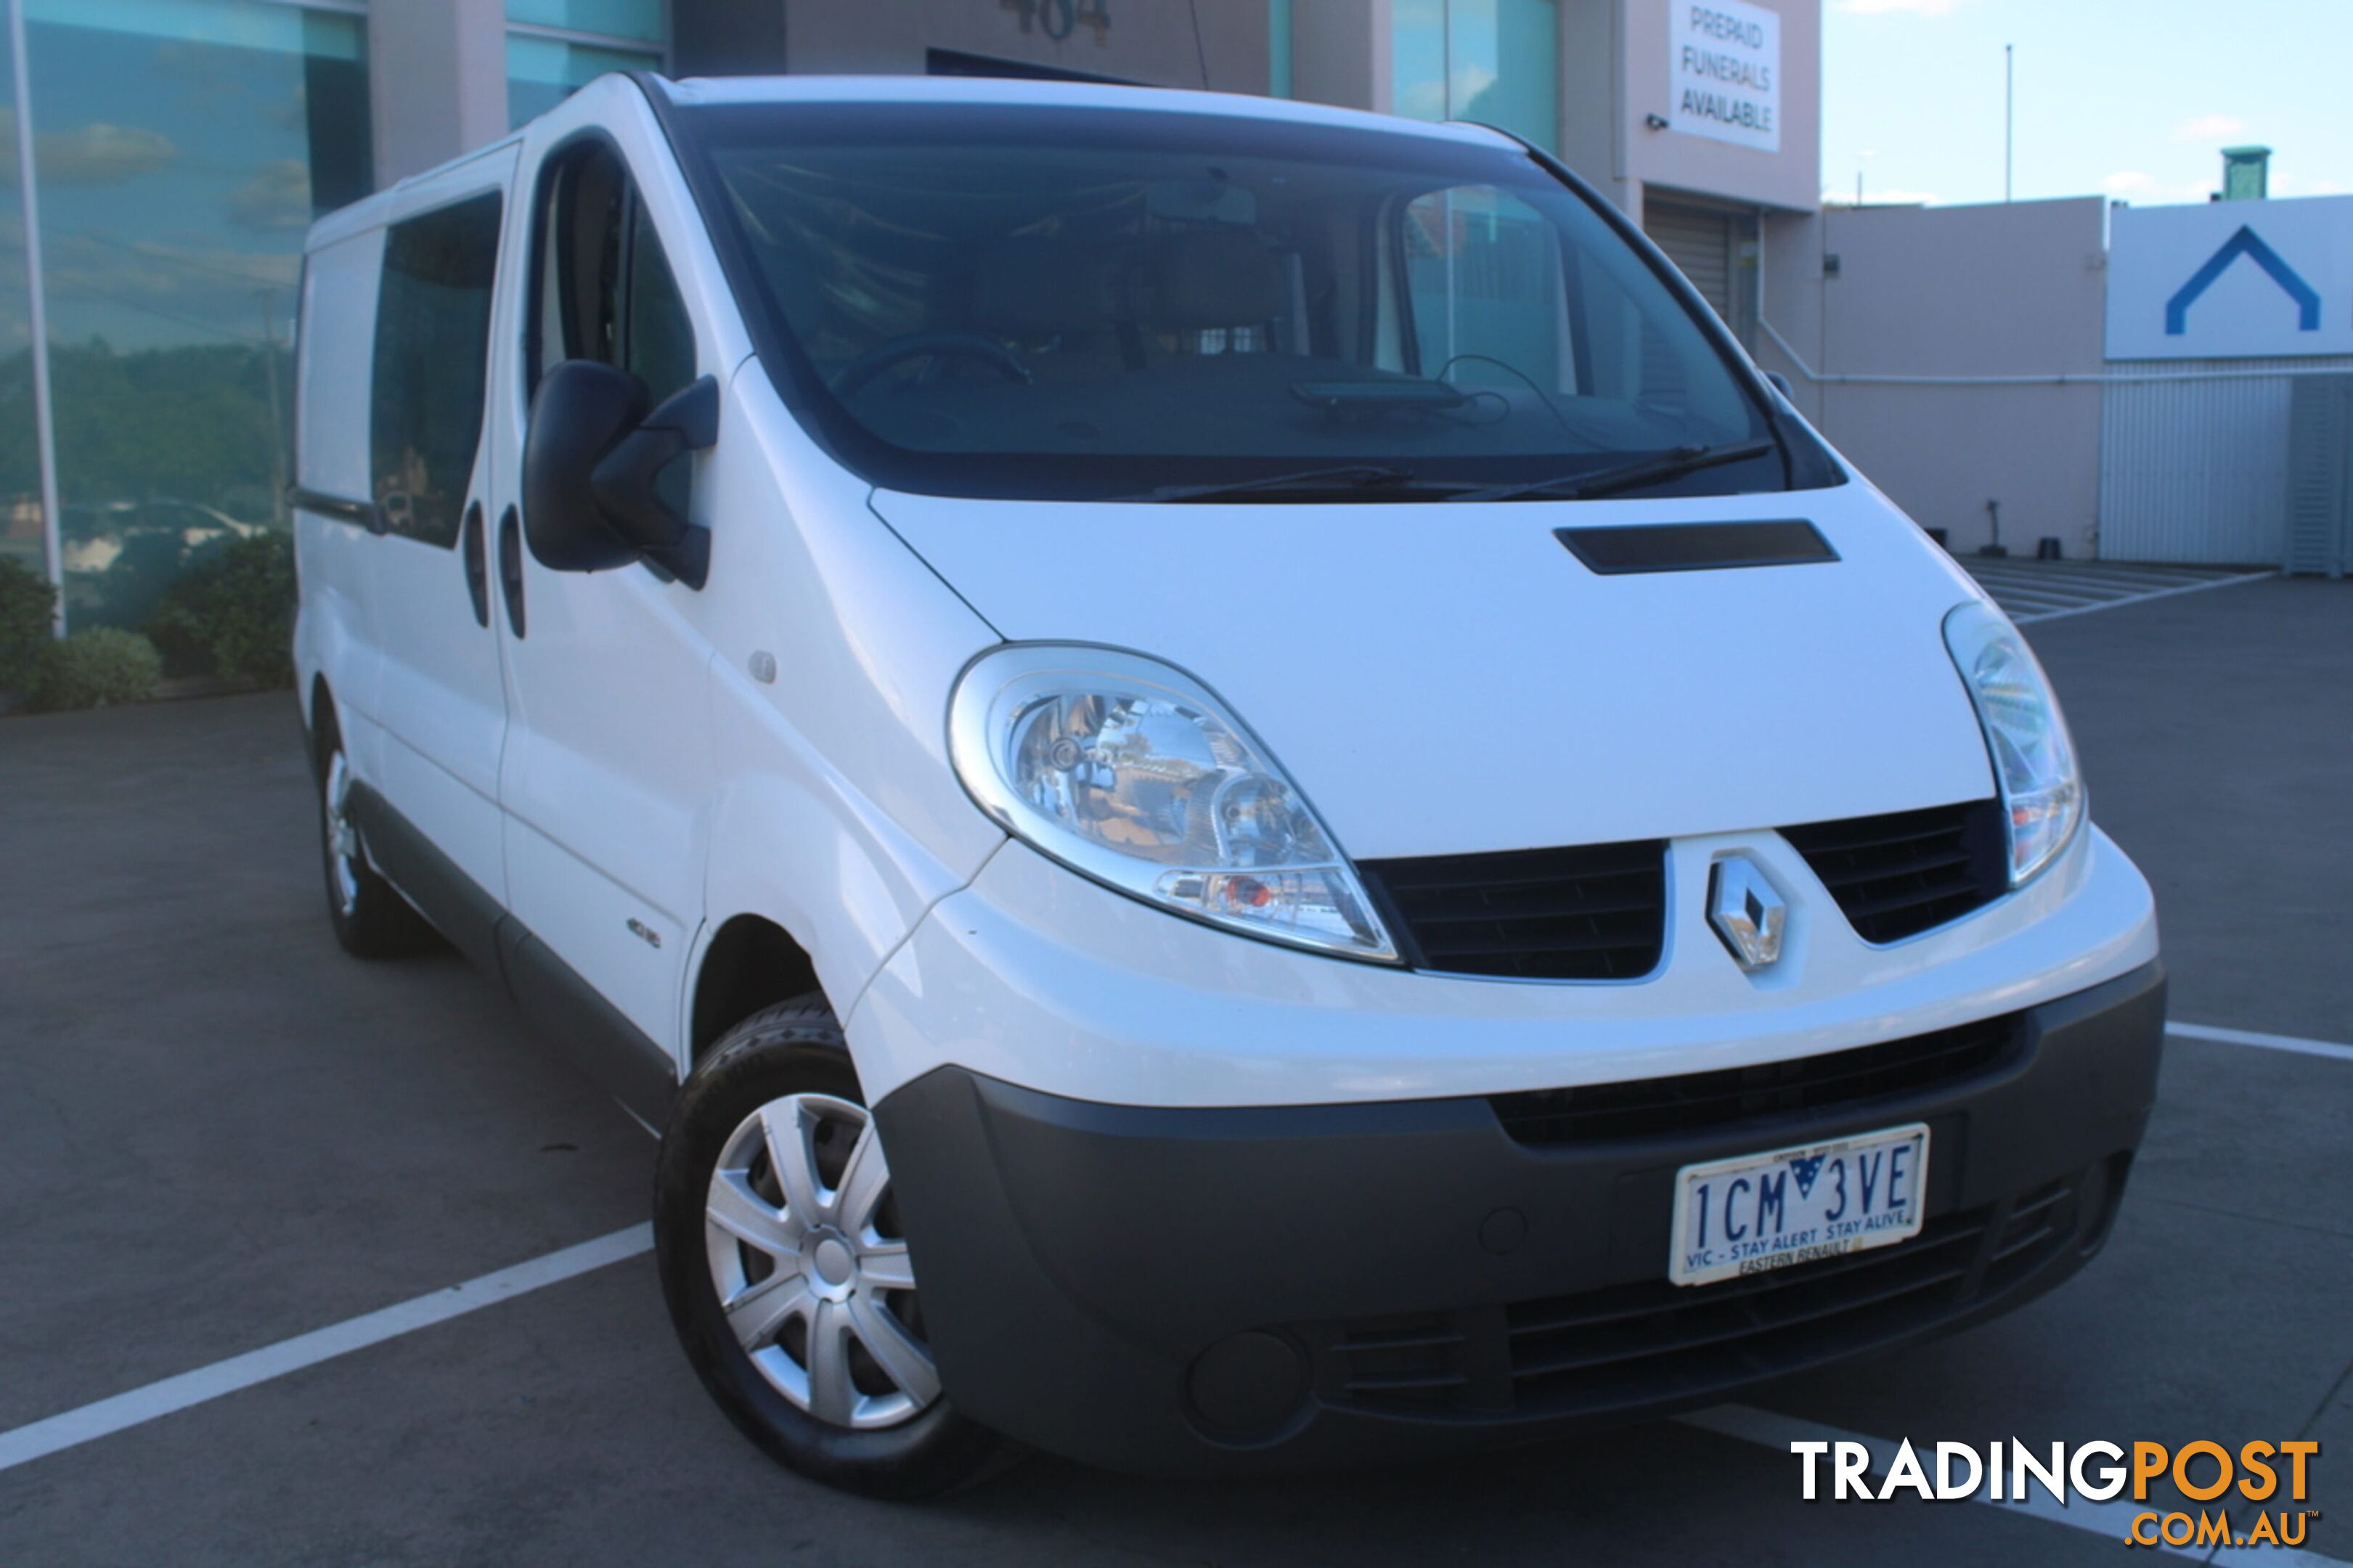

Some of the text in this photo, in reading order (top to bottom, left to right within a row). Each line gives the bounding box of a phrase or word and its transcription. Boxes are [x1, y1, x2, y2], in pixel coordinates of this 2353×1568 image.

[1692, 6, 1763, 49] PREPAID
[1682, 45, 1770, 91] FUNERALS
[1681, 89, 1771, 131] AVAILABLE
[1697, 1145, 1911, 1249] 1CM 3VE
[1687, 1250, 1712, 1267] VIC
[1731, 1240, 1769, 1260] STAY
[1771, 1228, 1817, 1251] ALERT
[1826, 1220, 1862, 1240] STAY
[1864, 1210, 1905, 1231] ALIVE
[1739, 1239, 1851, 1274] EASTERN RENAULT
